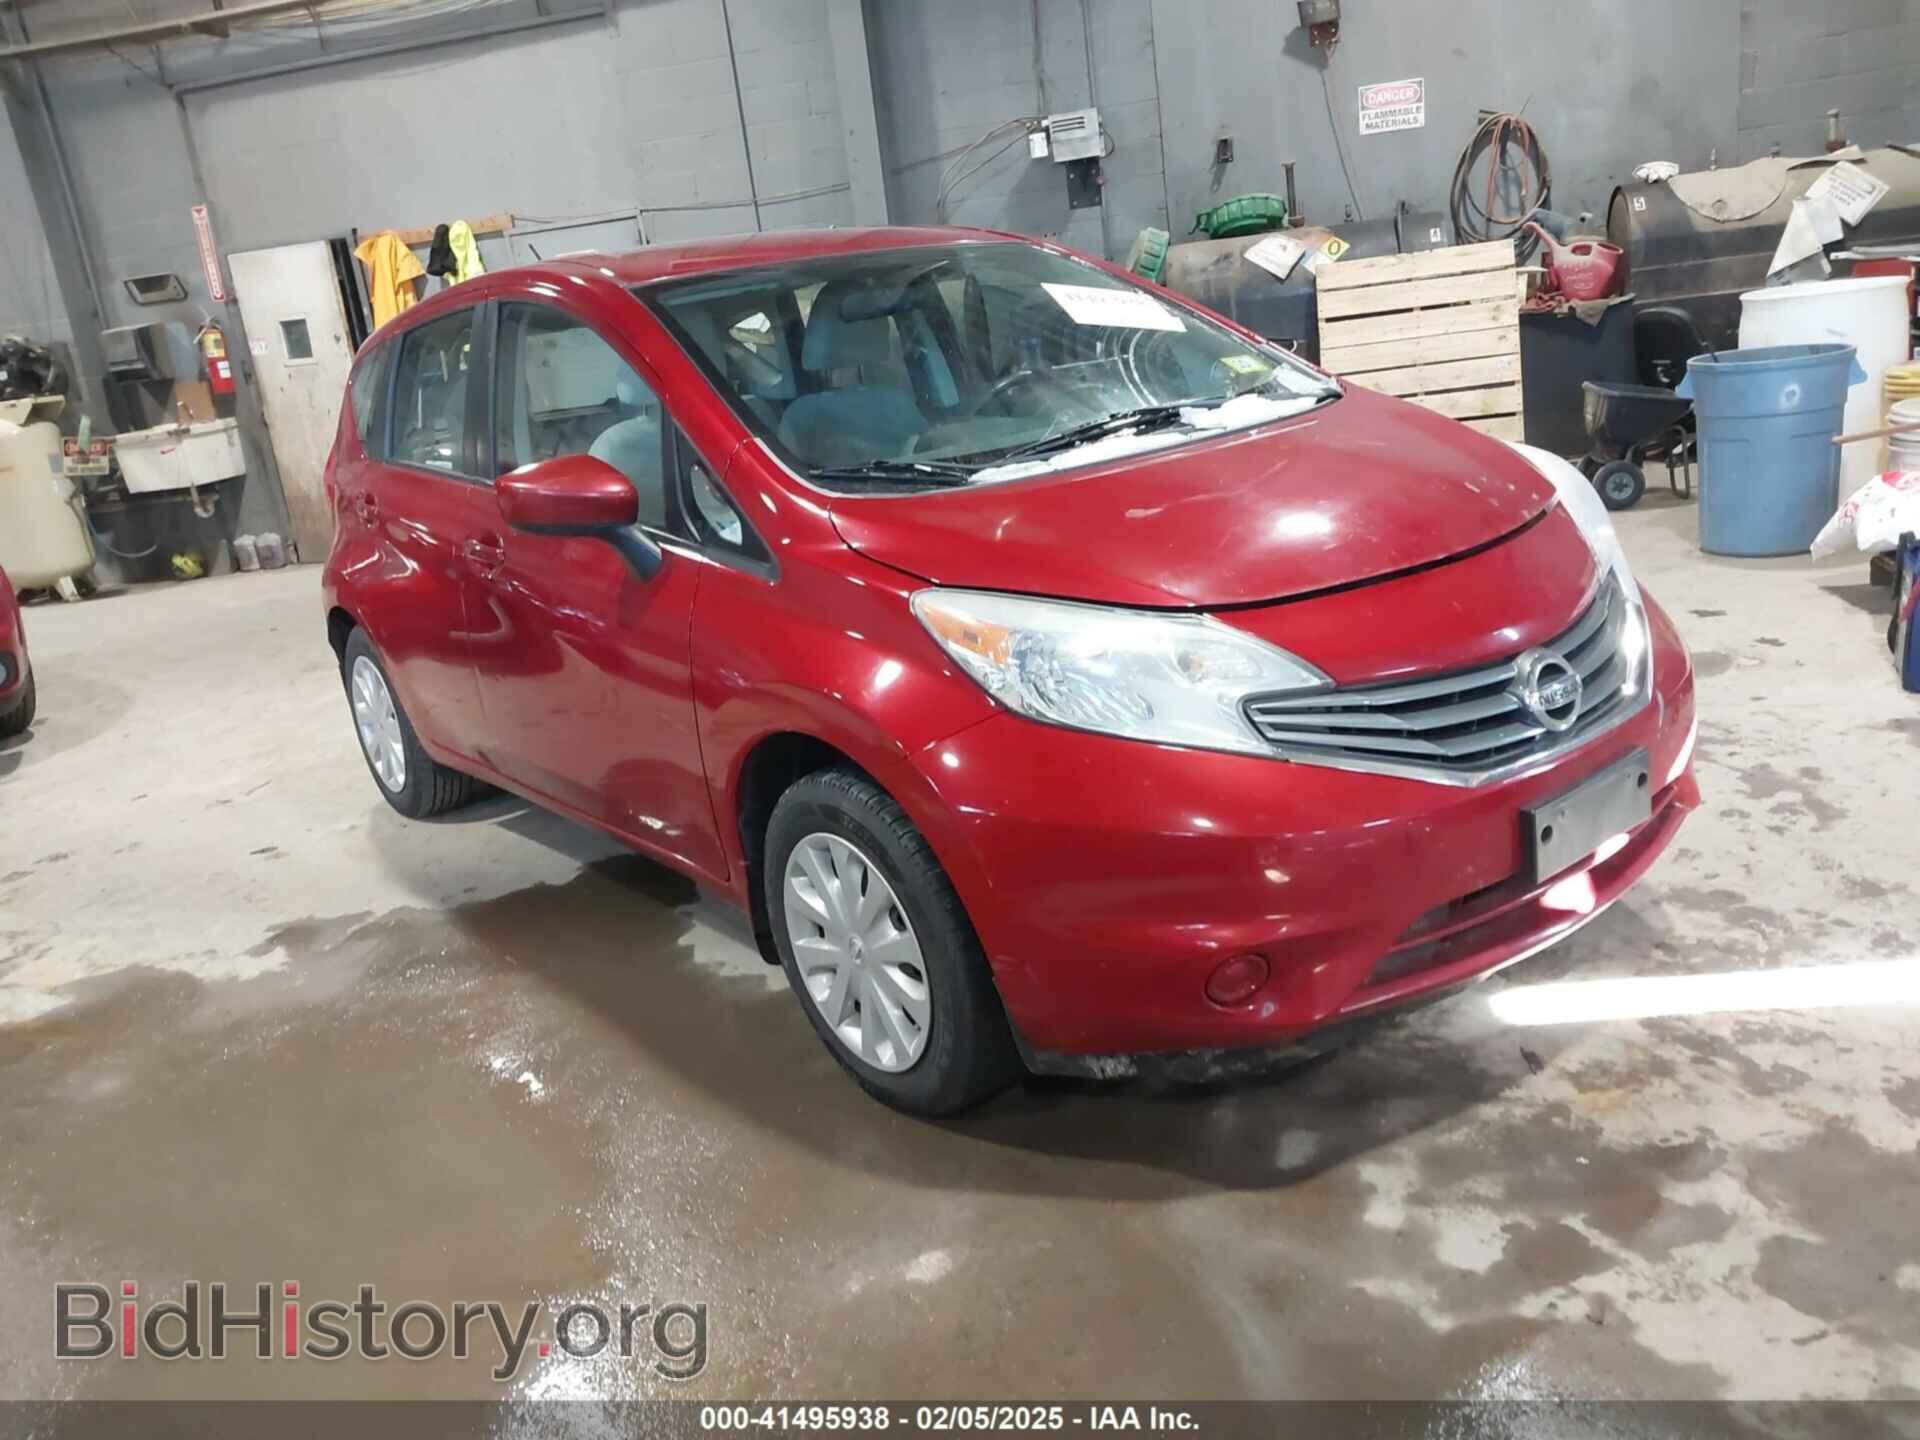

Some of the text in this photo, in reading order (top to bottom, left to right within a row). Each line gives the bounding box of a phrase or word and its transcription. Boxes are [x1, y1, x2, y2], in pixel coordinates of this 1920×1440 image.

[1368, 87, 1414, 105] DANGER
[1362, 105, 1422, 121] FLAMMABLE
[1365, 116, 1419, 130] MATERIALS
